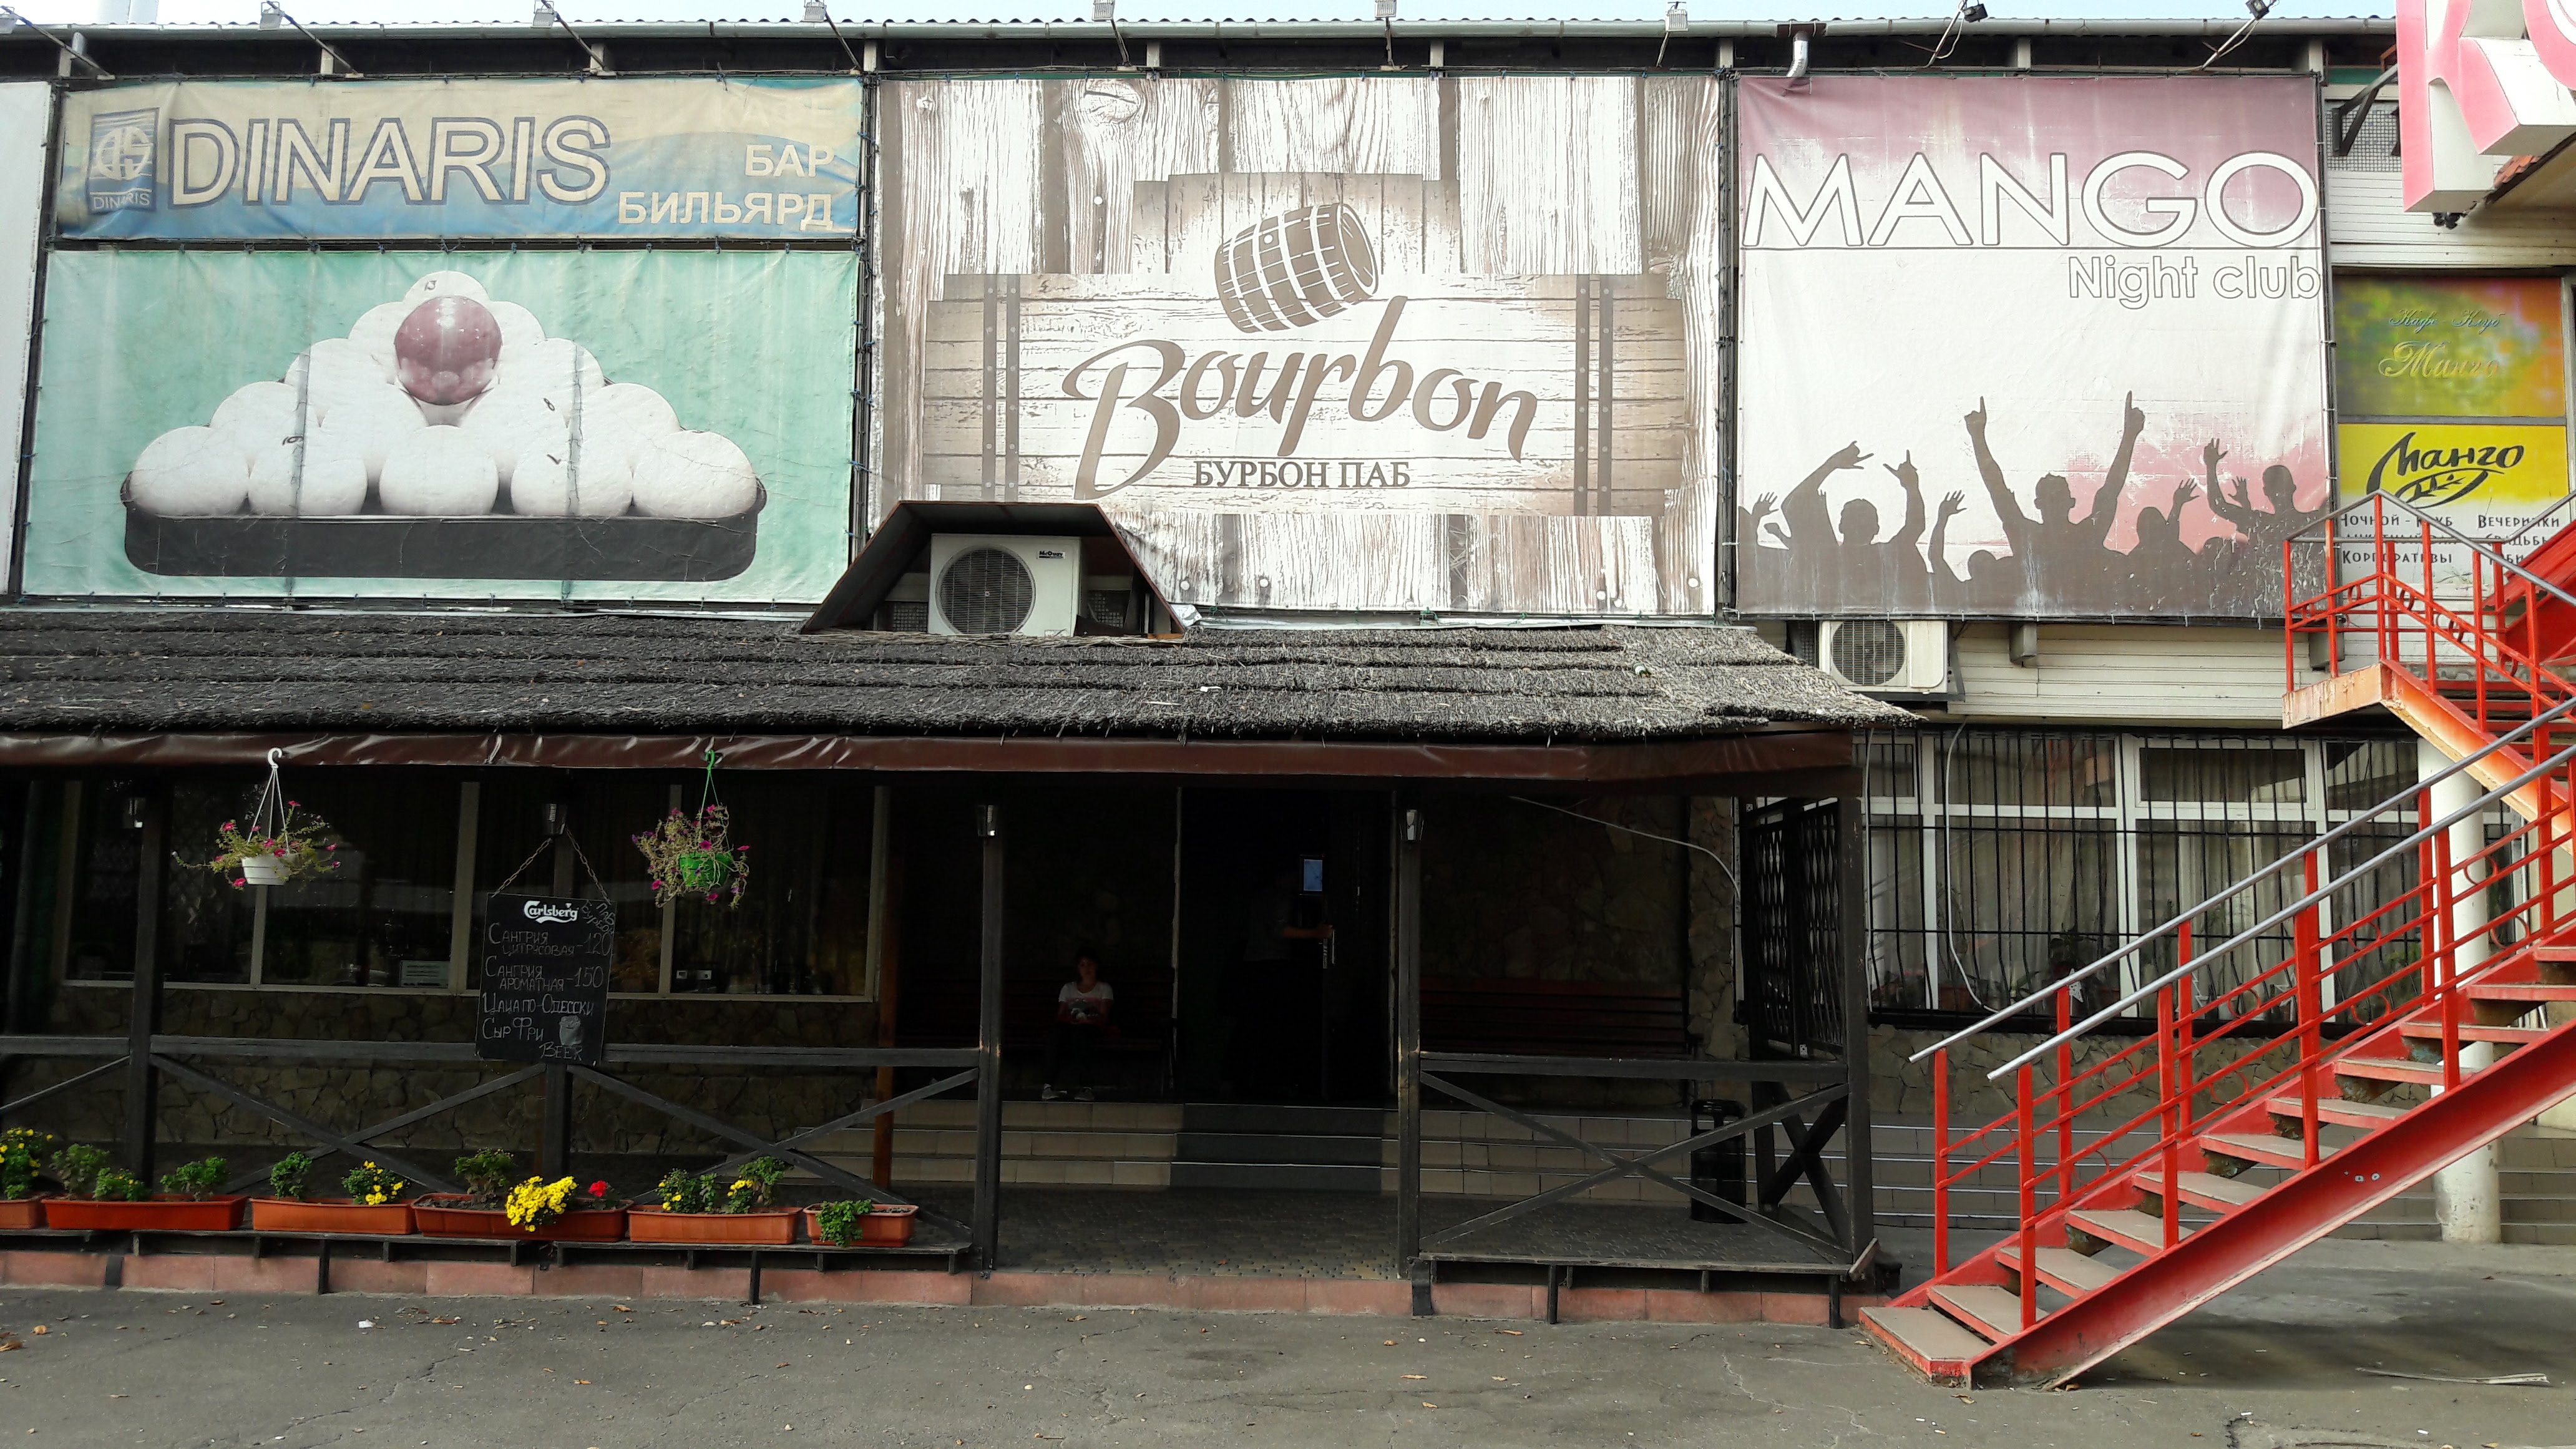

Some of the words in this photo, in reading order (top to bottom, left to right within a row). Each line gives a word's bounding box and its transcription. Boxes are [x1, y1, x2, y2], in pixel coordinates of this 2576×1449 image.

[168, 115, 610, 208] DINARIS
[744, 144, 835, 177] БАР
[94, 193, 150, 209] DINARIS
[618, 191, 834, 231] БИЛЬЯРД
[1742, 150, 2319, 247] MANGO
[2068, 256, 2198, 310] Night
[2213, 256, 2323, 300] club
[2379, 341, 2499, 379] Манго
[1061, 295, 1537, 500] Bourbon
[1193, 461, 1330, 489] БУРБОН
[1338, 461, 1410, 488] ПАБ
[2366, 432, 2524, 495] Манго
[524, 900, 579, 924] Carlsberg
